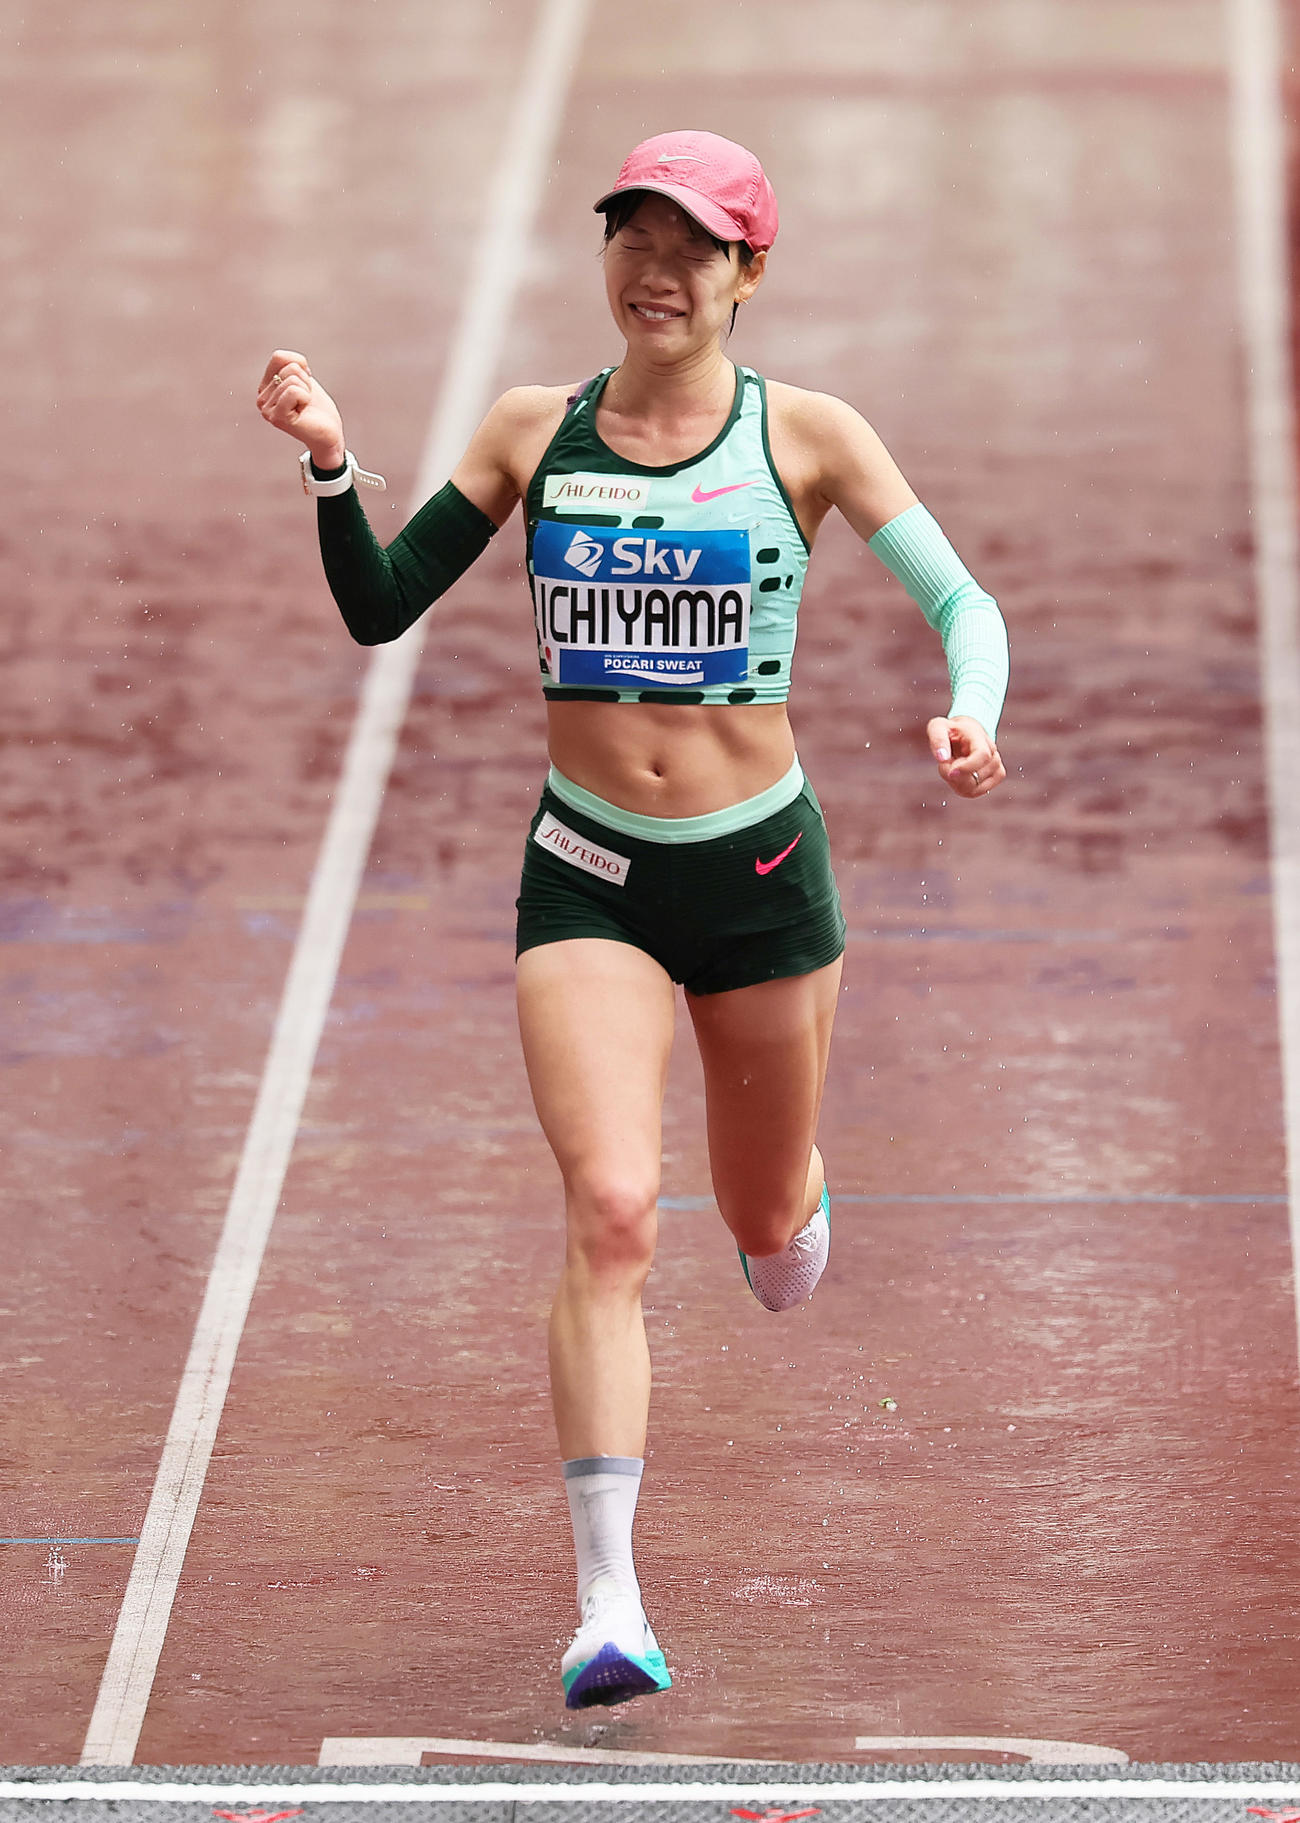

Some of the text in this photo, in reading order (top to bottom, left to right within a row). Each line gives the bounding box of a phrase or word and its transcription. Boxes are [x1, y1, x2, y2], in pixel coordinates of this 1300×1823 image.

[550, 482, 641, 501] SHISEIDO
[611, 537, 703, 582] Sky
[541, 583, 743, 647] ICHIYAMA
[604, 658, 703, 671] POCARI SWEAT
[541, 828, 621, 875] SHISEIDO
